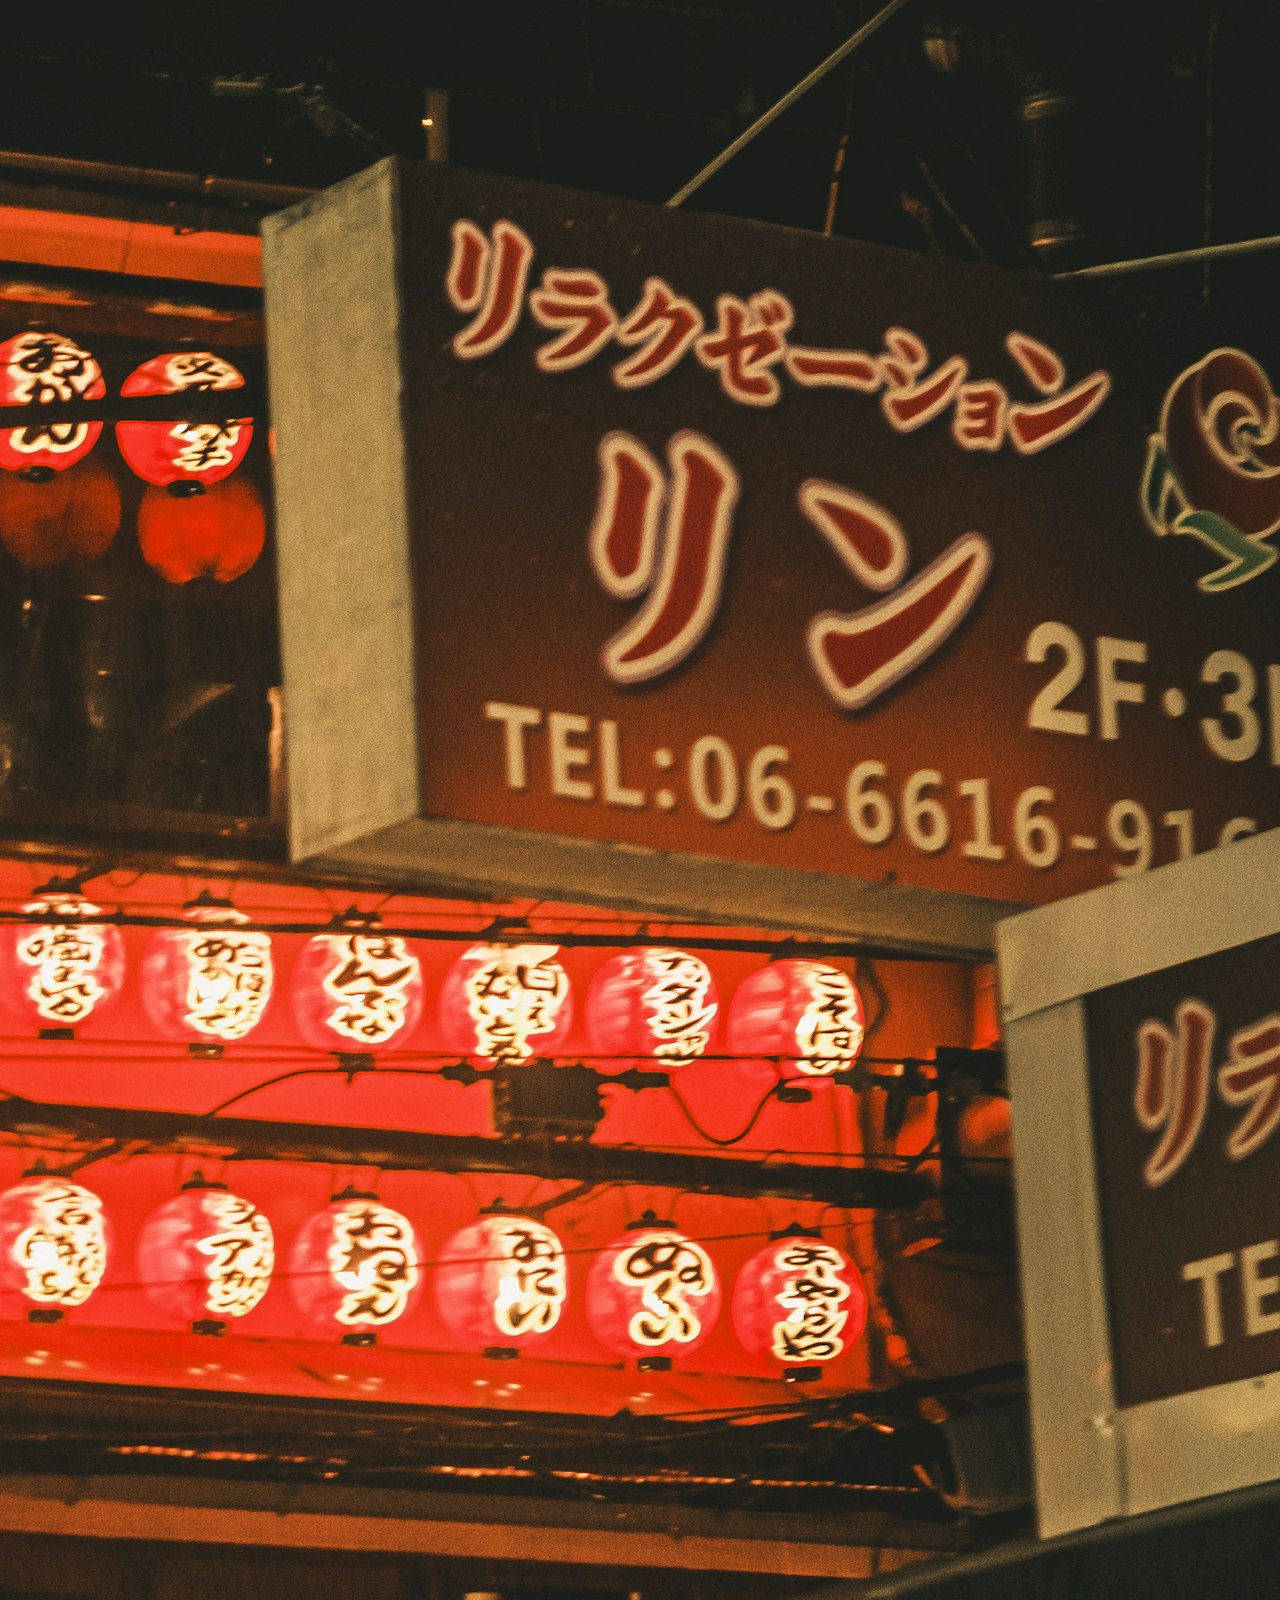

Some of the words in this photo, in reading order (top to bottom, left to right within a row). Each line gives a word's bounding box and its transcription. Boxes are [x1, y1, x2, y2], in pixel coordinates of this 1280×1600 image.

[445, 219, 1111, 454] リラクゼーション
[591, 429, 992, 709] リン
[1025, 620, 1280, 767] 2F·3
